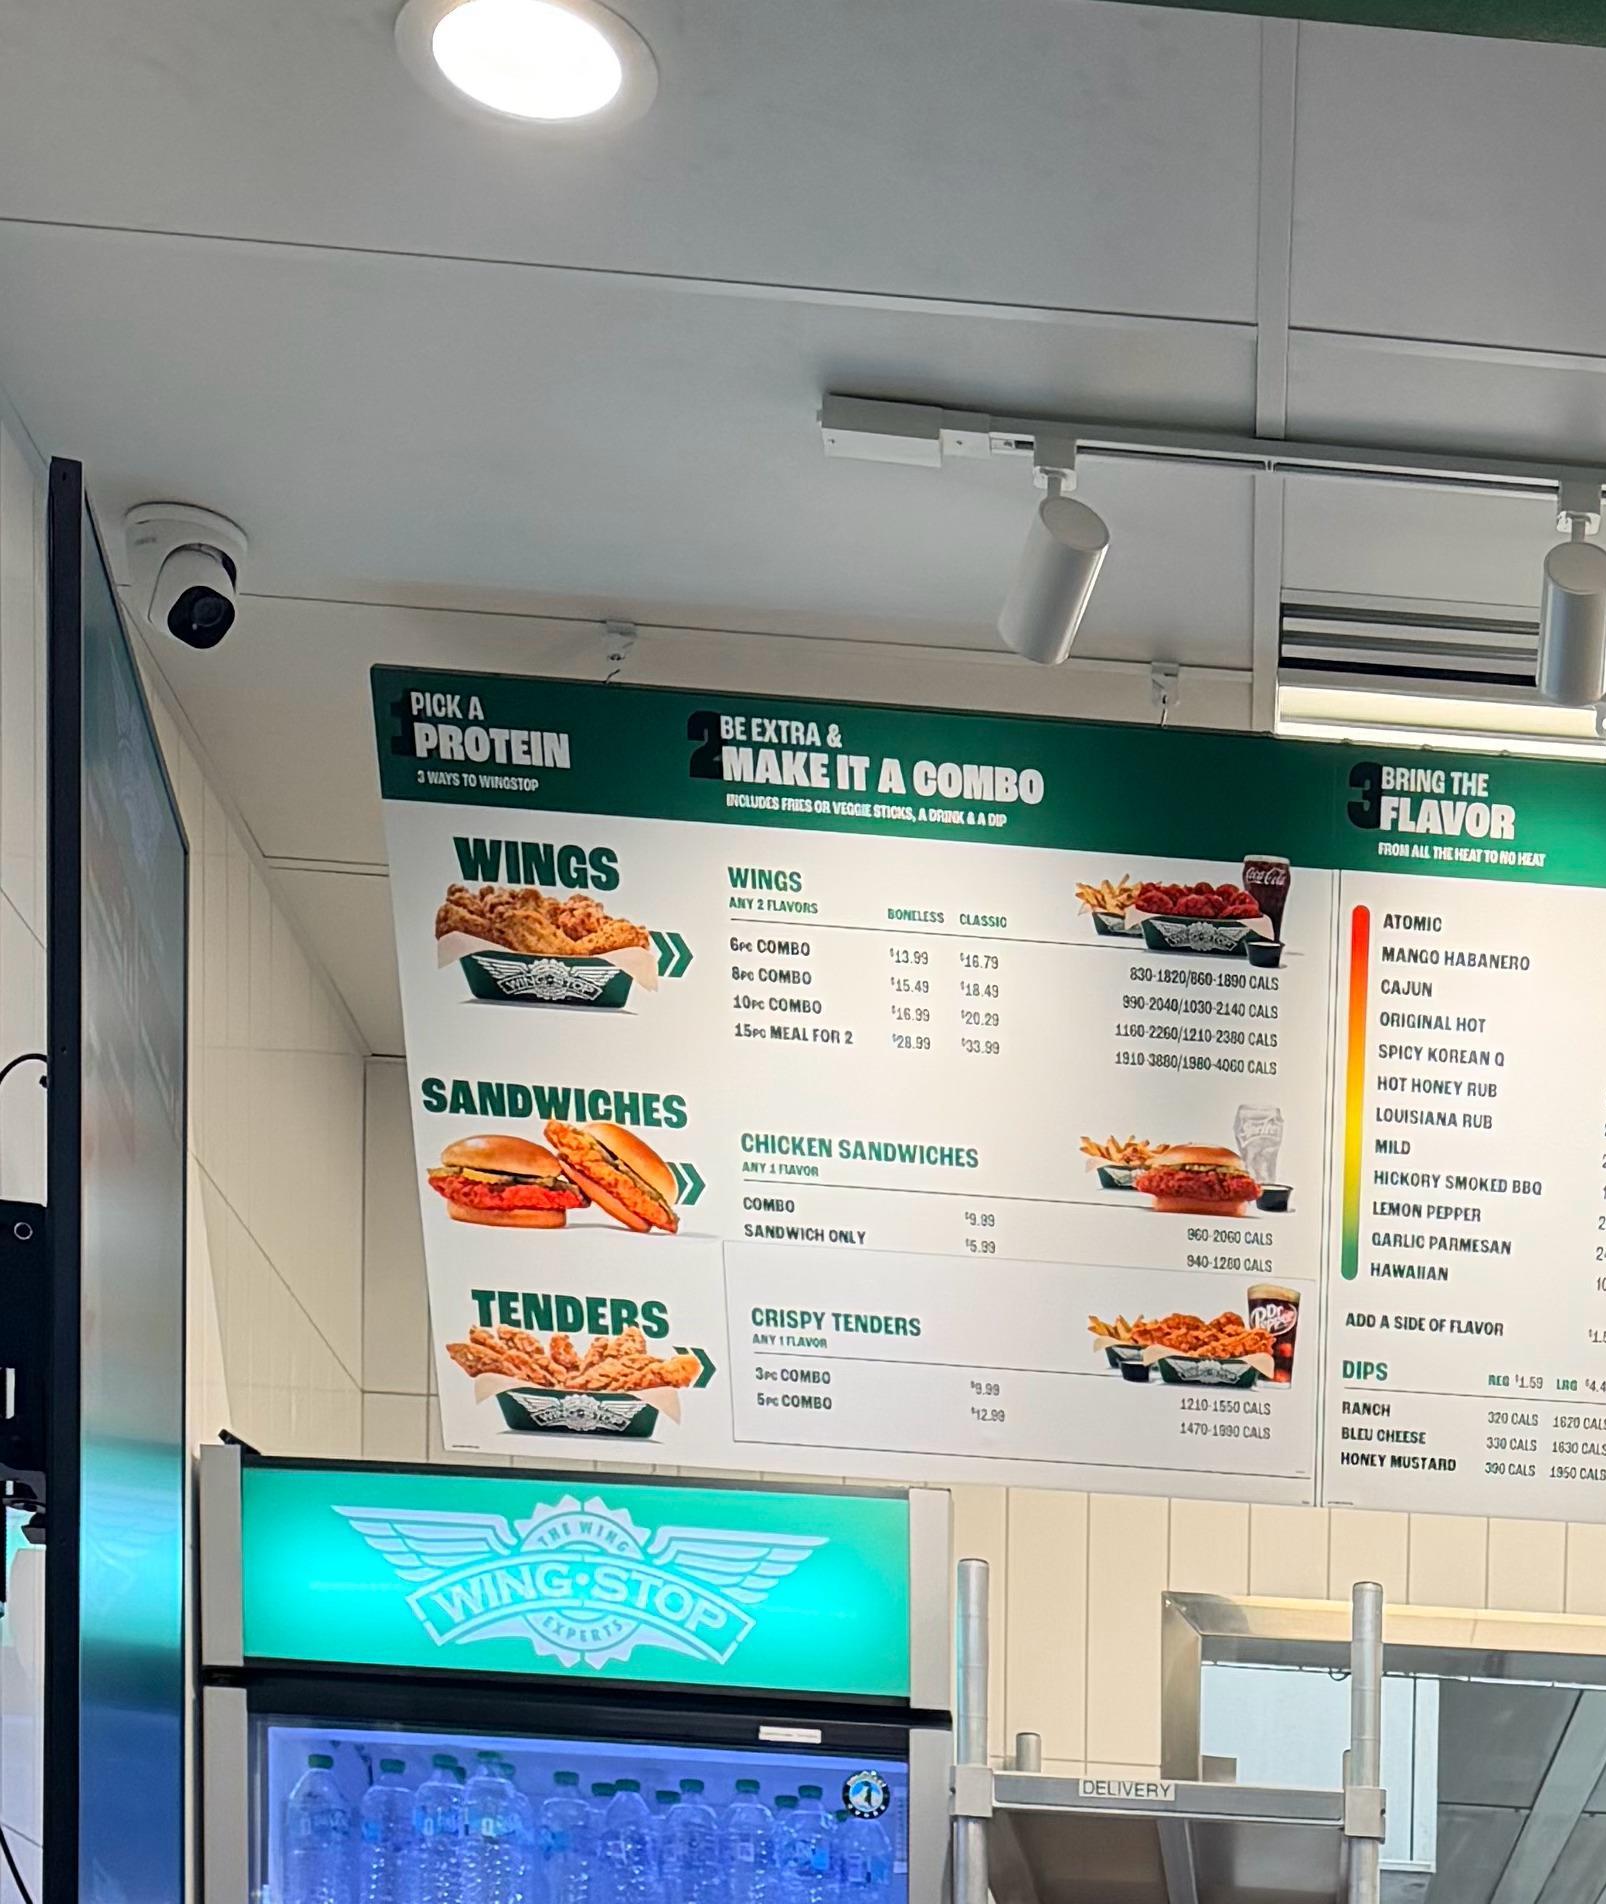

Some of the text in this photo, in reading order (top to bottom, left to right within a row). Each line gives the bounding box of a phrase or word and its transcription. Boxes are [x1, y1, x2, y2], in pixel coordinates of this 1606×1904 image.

[411, 692, 484, 720] PICK A
[721, 715, 842, 748] BE EXTRA &
[414, 723, 571, 768] PROTEIN
[418, 771, 539, 792] 3 WAYS TO WINGSTOP
[723, 748, 1045, 805] MAKE IT A COMBO
[1381, 766, 1489, 797] BRING THE
[1379, 797, 1516, 840] FLAVOR
[453, 836, 620, 891] WINGS
[728, 867, 802, 893] WINGS
[729, 897, 818, 916] ANY 2 FLAVORS
[1383, 914, 1442, 932] ATOMIC
[1382, 947, 1530, 972] MANGO HABANERO
[758, 968, 812, 987] COMBO
[1381, 979, 1432, 998] CAJUN
[1380, 1012, 1486, 1033] ORIGINAL HOT
[770, 1026, 808, 1044] MEAL
[811, 1028, 839, 1045] FOR
[845, 1031, 853, 1045] 2
[1379, 1044, 1505, 1068] SPICY KOREAN Q
[1378, 1076, 1498, 1098] HOT HONEY RUB
[421, 1077, 687, 1129] SANDWICHES
[1376, 1107, 1492, 1129] LOUISIANA RUB
[741, 1132, 979, 1169] CHICKEN SANDWICHES
[1375, 1139, 1411, 1155] MILD
[1374, 1170, 1542, 1196] HICKORY SMOKED BBQ
[1372, 1232, 1512, 1255] GARLIC PARMESAN
[1370, 1262, 1448, 1281] HAWAIIAN
[471, 1289, 669, 1339] TENDERS
[751, 1307, 922, 1337] CRISPY TENDERS
[1342, 1360, 1388, 1381] DIPS
[1340, 1452, 1456, 1472] HONEY MUSTARD
[537, 1520, 631, 1554] THE WING
[541, 1614, 625, 1643] EXPERTS
[1082, 1779, 1171, 1798] DELIVERY
